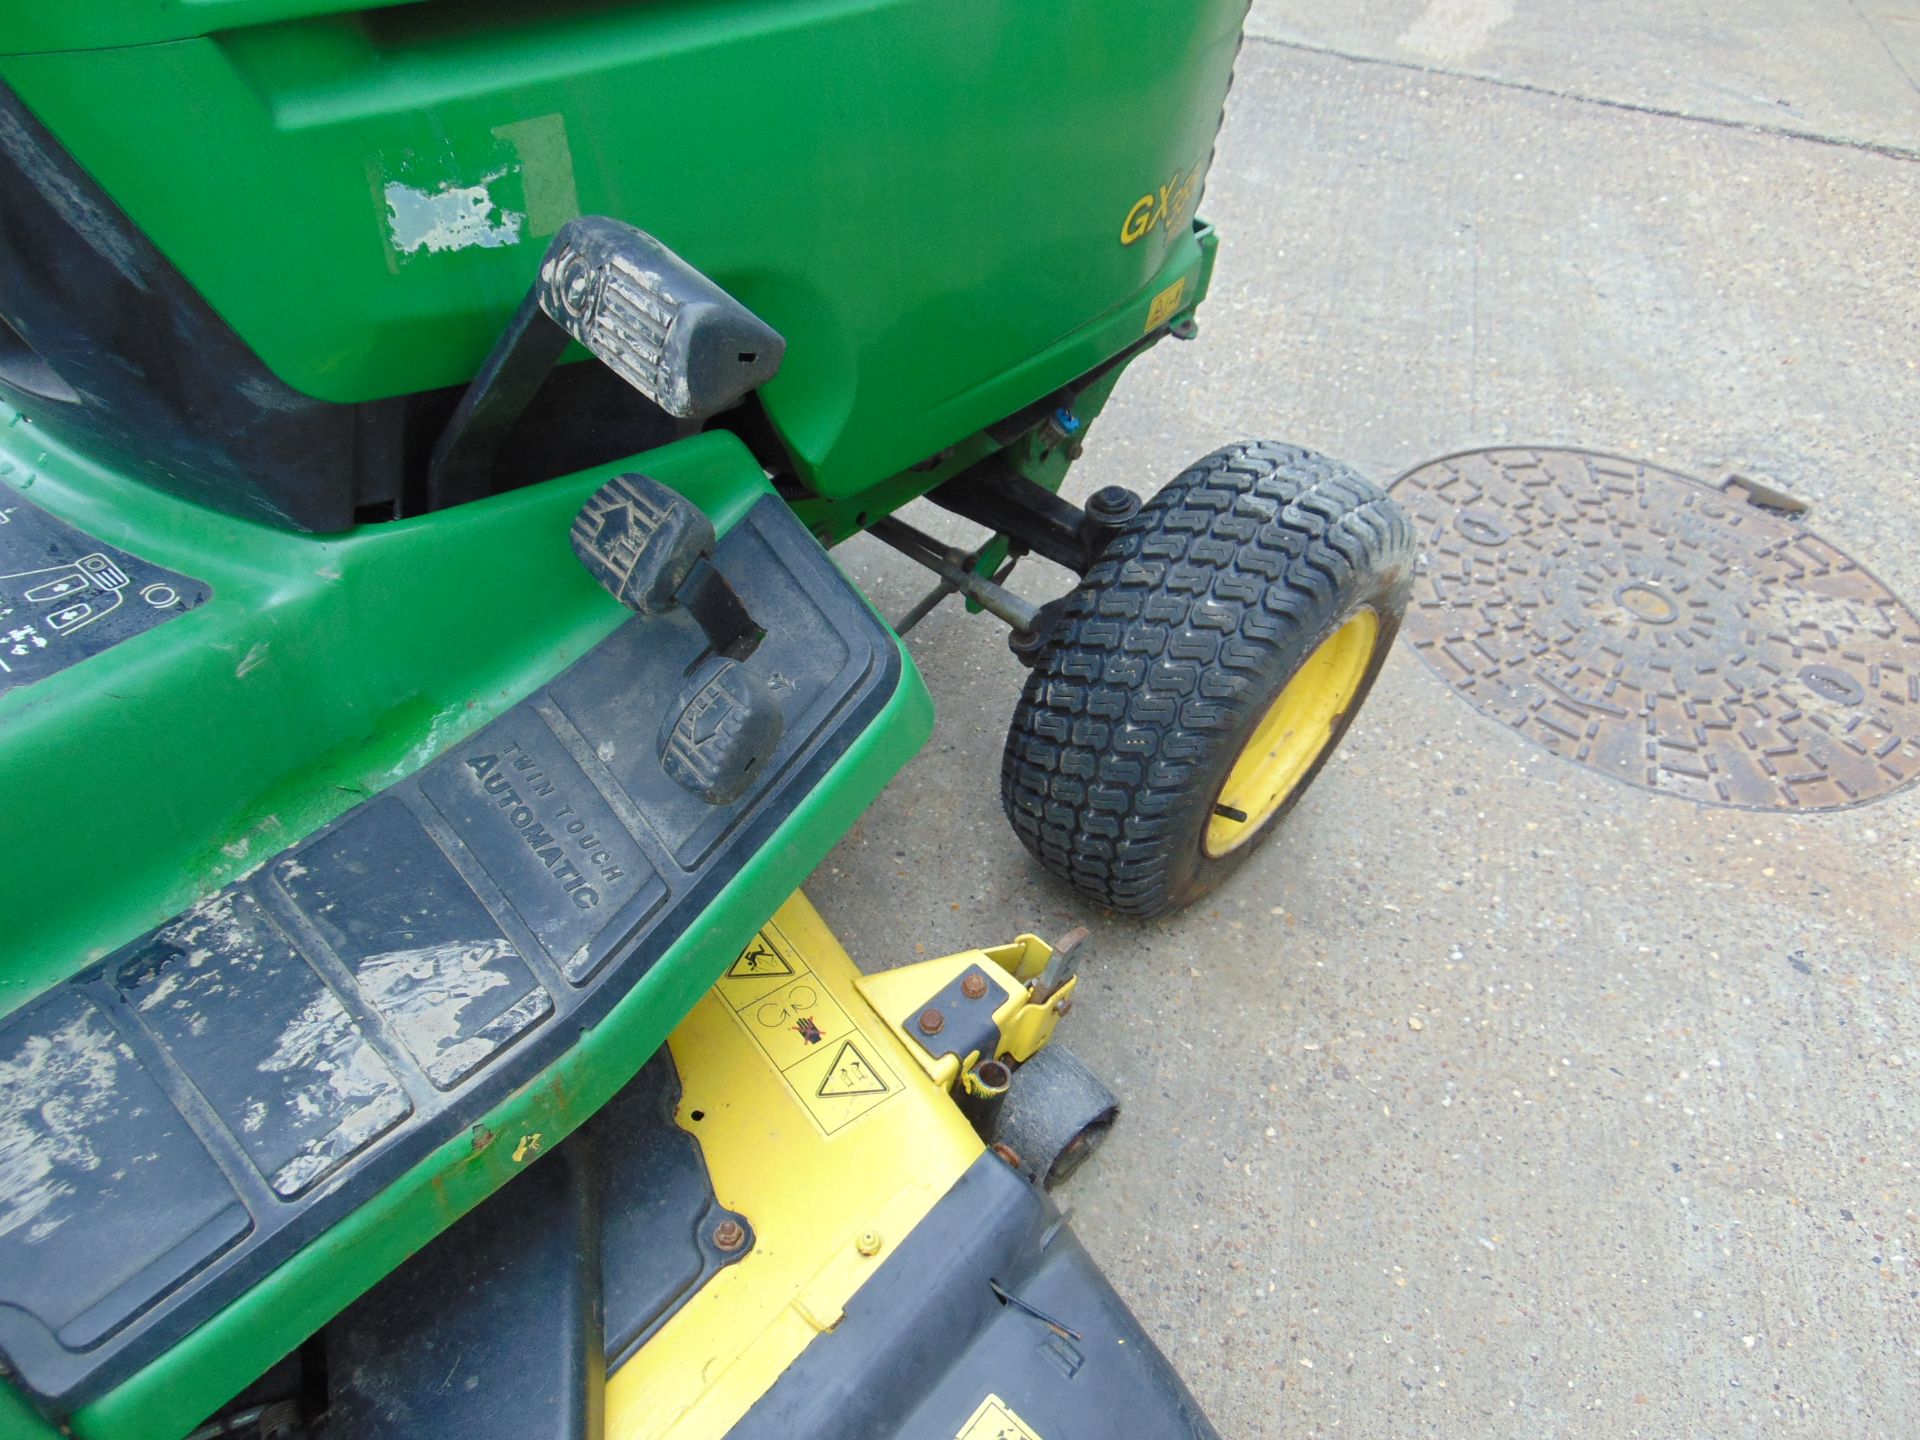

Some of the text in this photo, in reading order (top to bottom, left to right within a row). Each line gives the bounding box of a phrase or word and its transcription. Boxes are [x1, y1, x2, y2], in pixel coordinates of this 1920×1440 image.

[465, 753, 600, 910] AUTOMATIC
[502, 741, 624, 882] TWIN TOUCH
